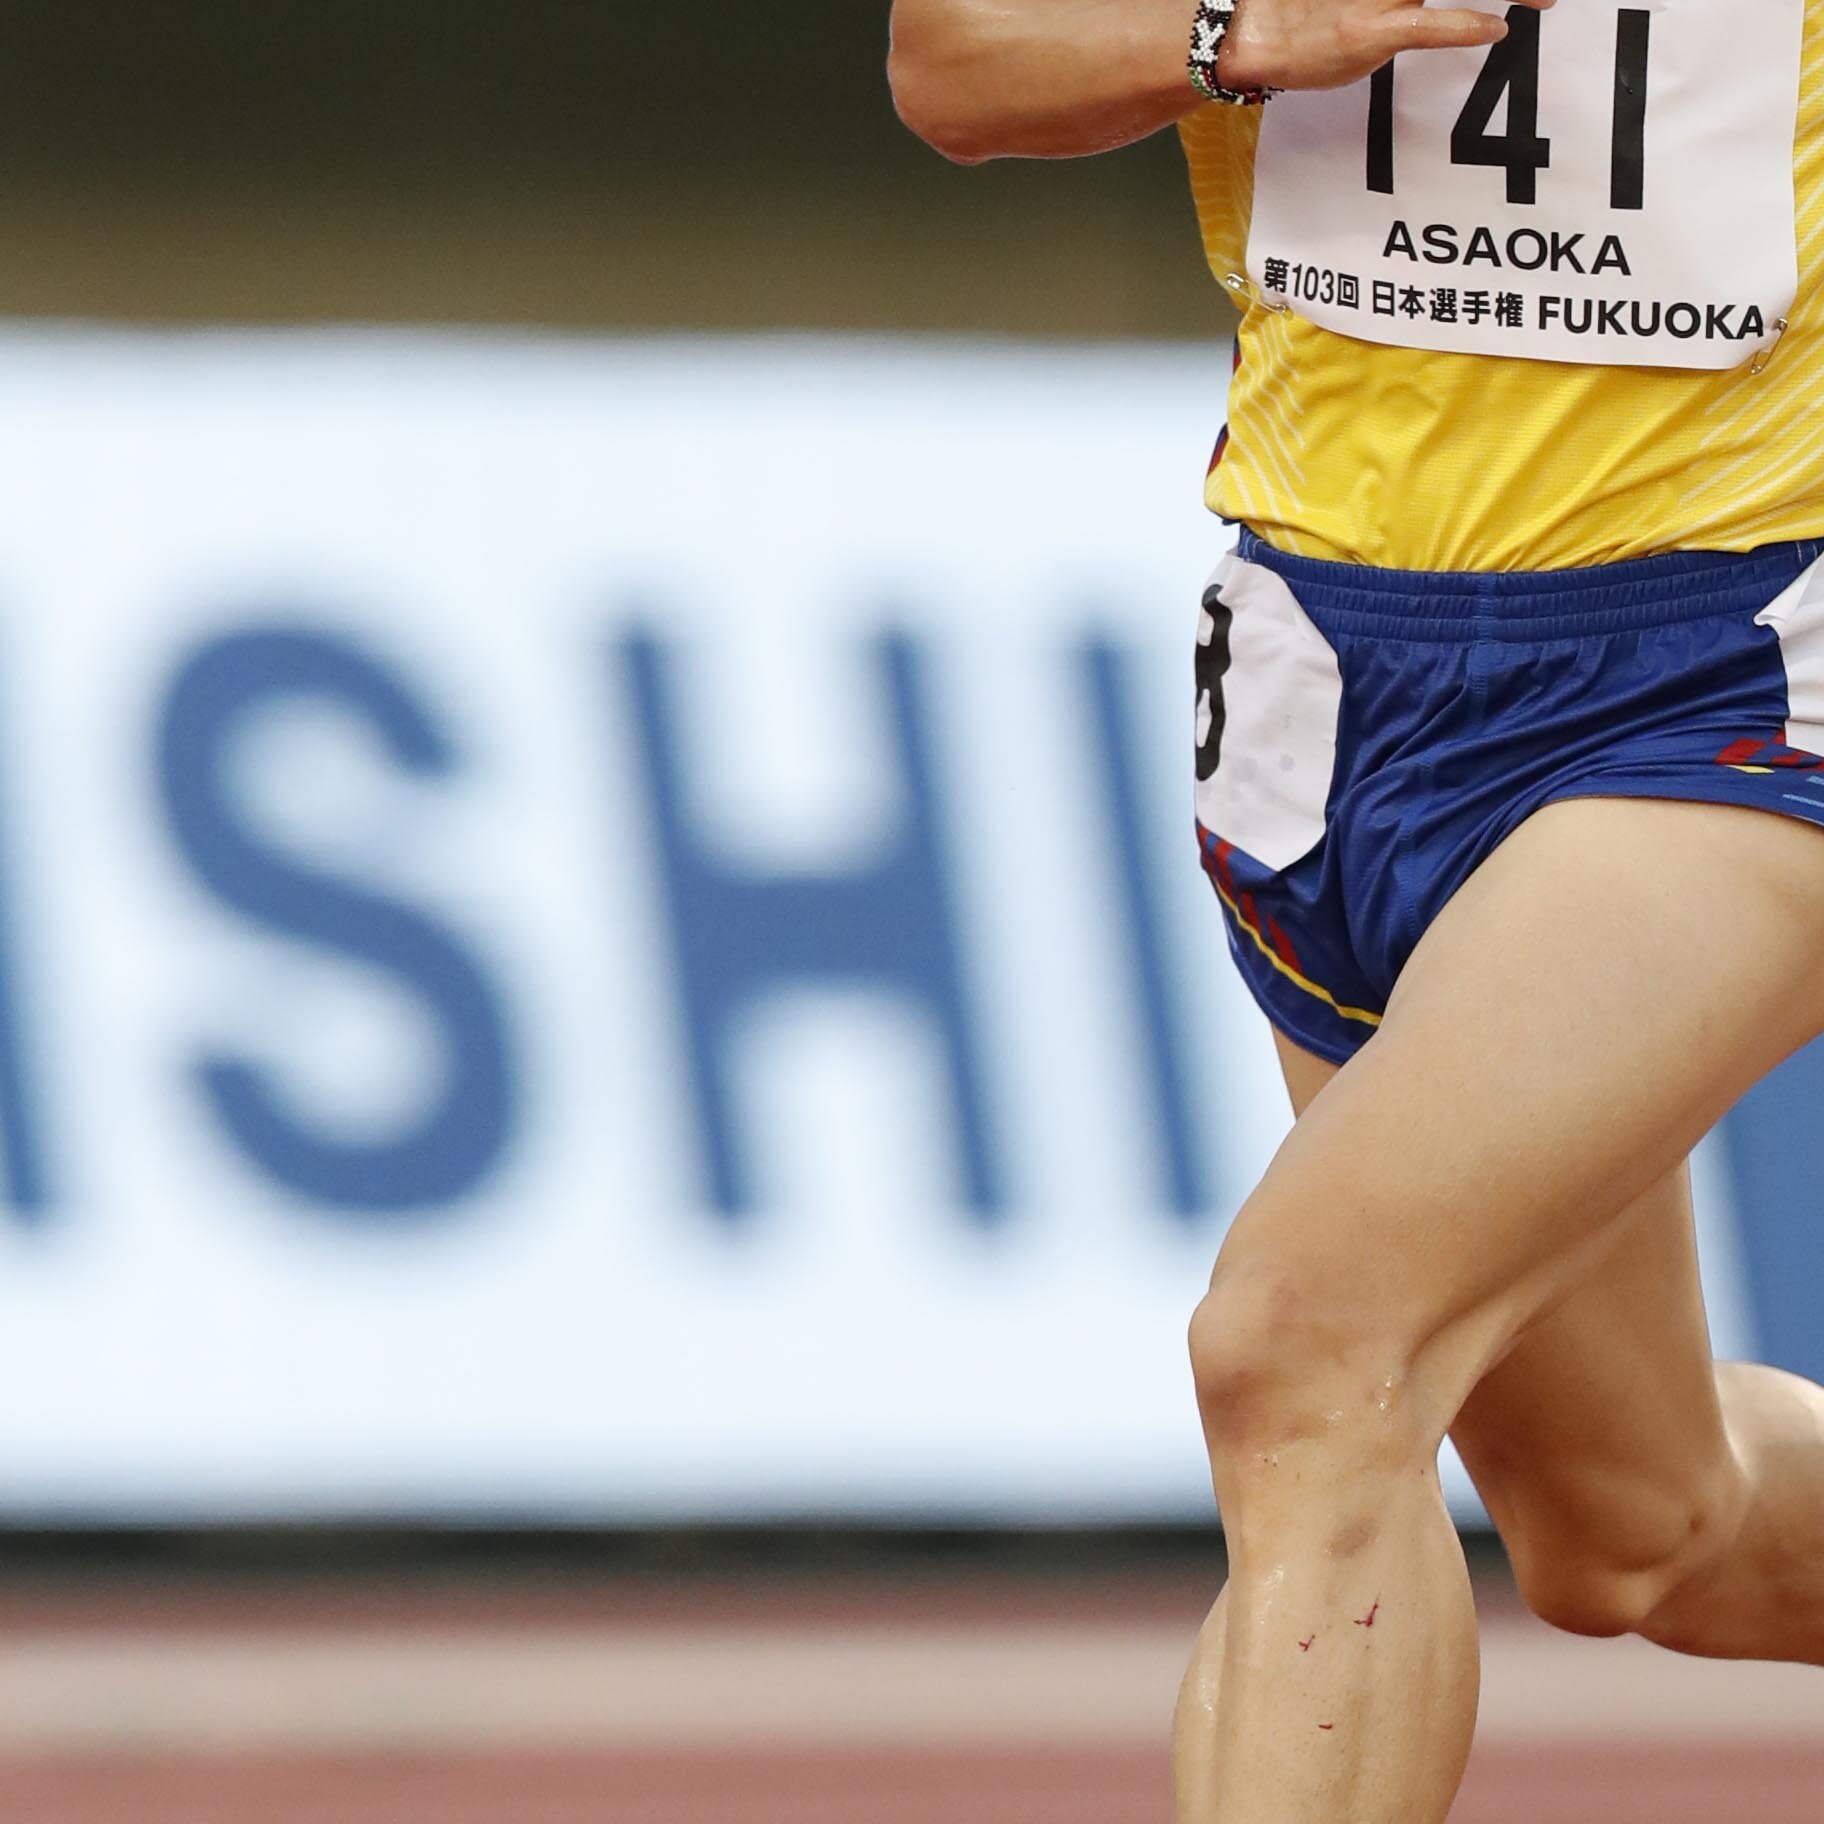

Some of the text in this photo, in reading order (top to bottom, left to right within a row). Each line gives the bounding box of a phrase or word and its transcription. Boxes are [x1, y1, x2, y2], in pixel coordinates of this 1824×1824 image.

[1366, 2, 1650, 210] 141
[1383, 220, 1631, 275] ASAOKA
[1264, 257, 1764, 340] 第103回 日本選手権 FUKUOKA
